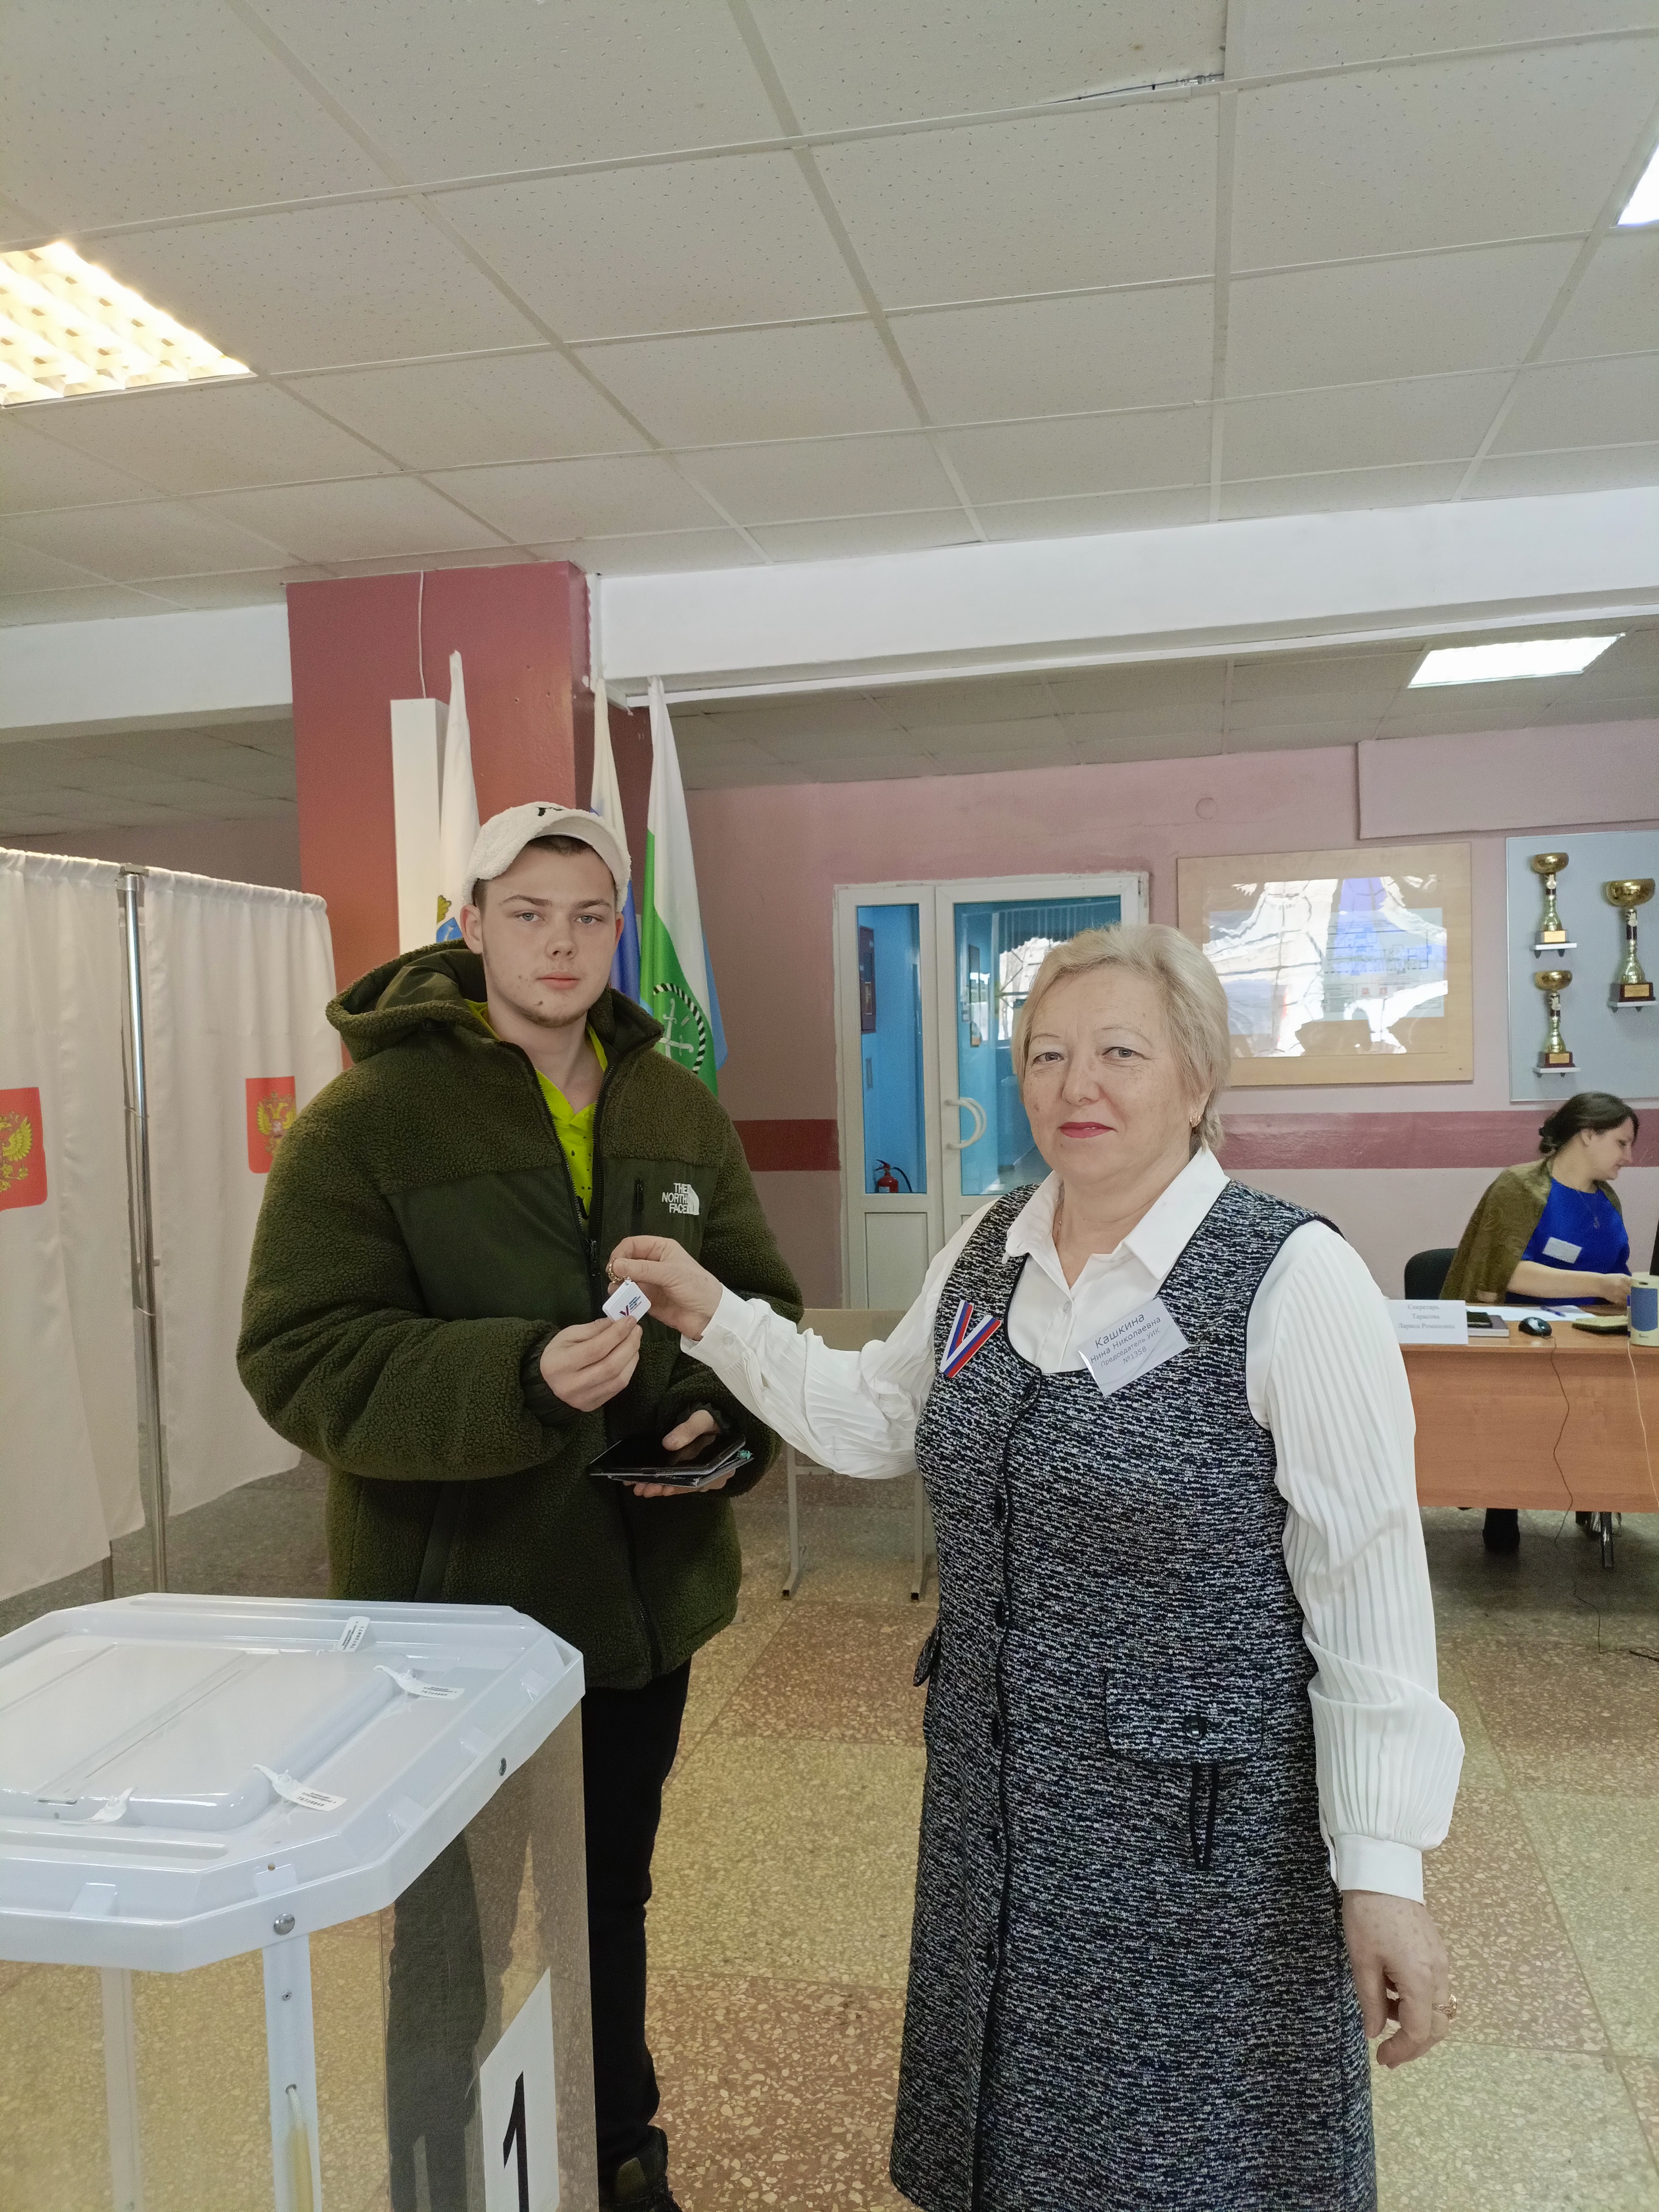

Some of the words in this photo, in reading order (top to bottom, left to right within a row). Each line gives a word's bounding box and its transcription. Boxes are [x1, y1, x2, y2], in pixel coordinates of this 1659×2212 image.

[662, 1192, 687, 1203] NORTH
[673, 1183, 687, 1193] THE
[669, 1203, 687, 1214] FACE
[1091, 1348, 1110, 1363] Нина
[1113, 1317, 1161, 1349] Николаевна
[1095, 1314, 1144, 1348] Кашкина
[1101, 1339, 1145, 1367] Председатель
[1146, 1327, 1160, 1340] УИК
[1123, 1346, 1147, 1364] №1358
[503, 2070, 529, 2212] 1
